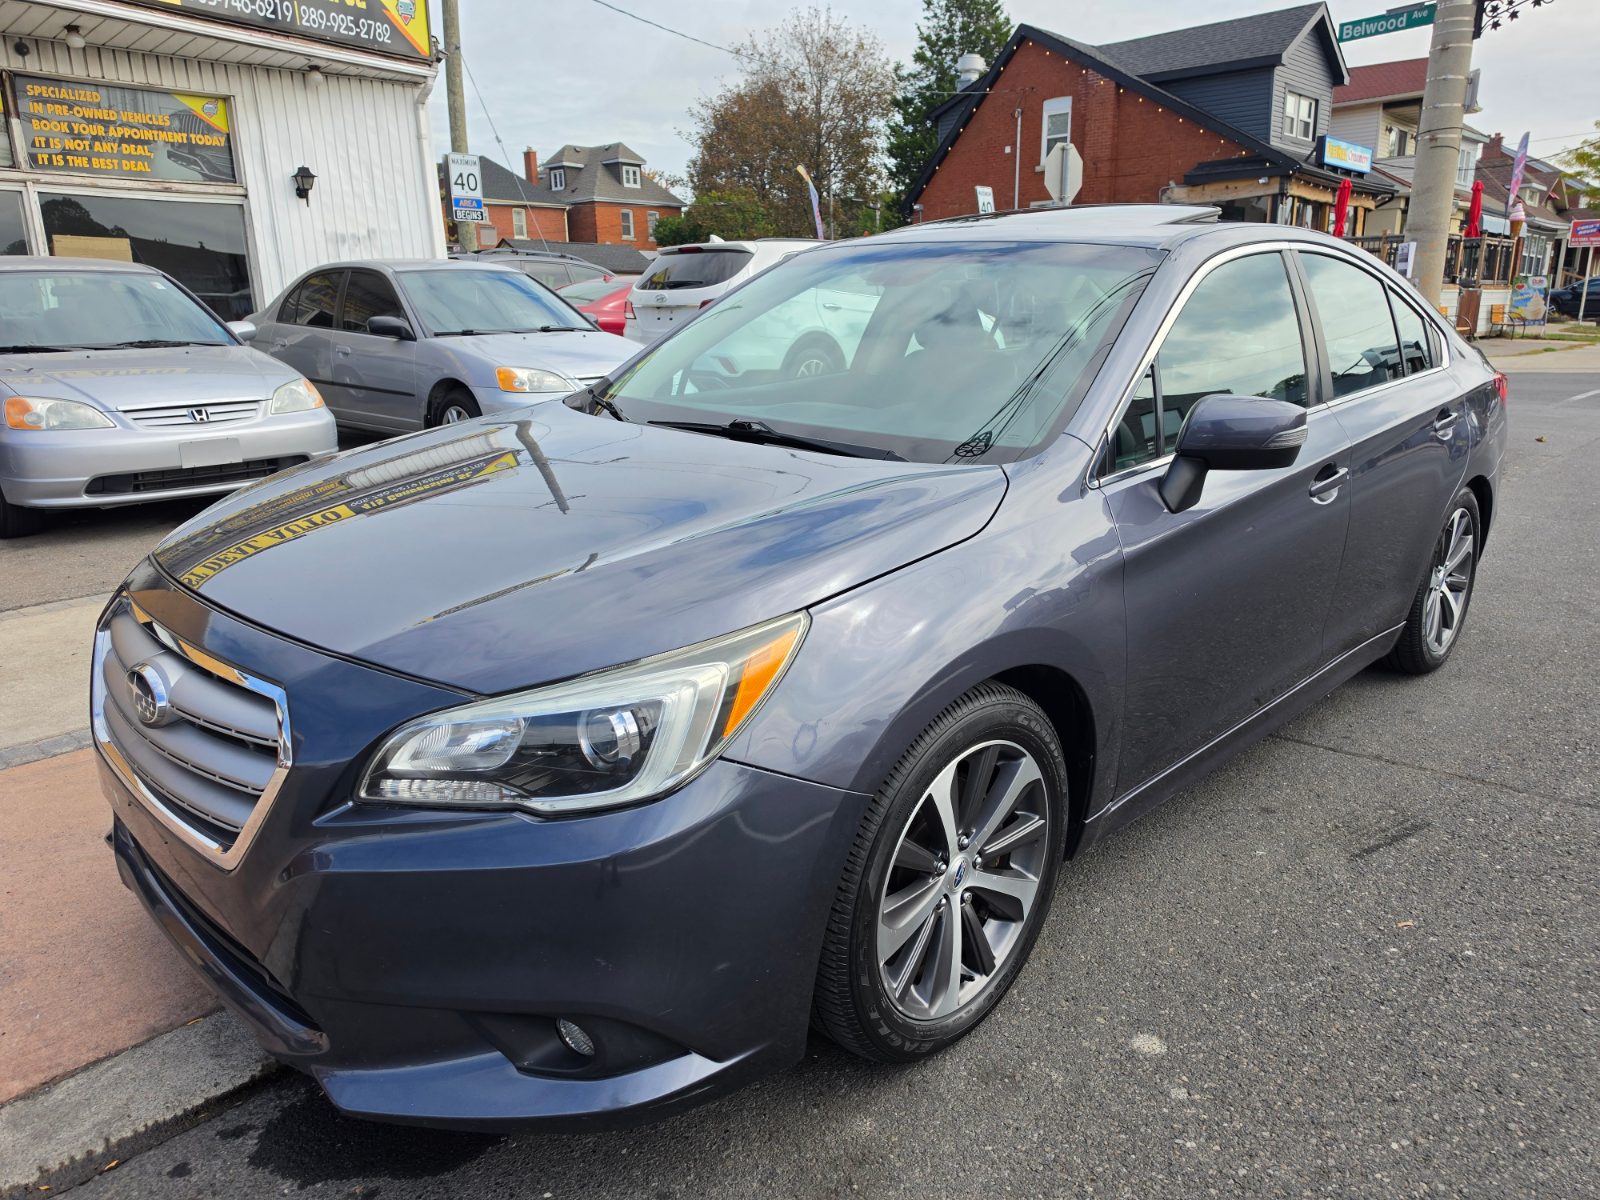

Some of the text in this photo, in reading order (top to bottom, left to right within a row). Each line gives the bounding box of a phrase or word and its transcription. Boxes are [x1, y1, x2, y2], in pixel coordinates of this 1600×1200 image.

[300, 5, 392, 44] 289-925-2782
[1342, 9, 1429, 39] Belwood Ave
[26, 84, 101, 103] SPECIALIZED
[29, 101, 170, 127] IN PRE-OWNED VEHICLES
[31, 118, 226, 147] BOOK YOUR APPOINTMENT TODAY
[34, 136, 154, 159] IT IS NOT ANY DEAL,
[37, 153, 151, 172] IT IS THE BEST DEAL
[451, 158, 477, 166] MAXIMUM
[453, 172, 478, 191] 40
[456, 210, 482, 220] BEGINS
[981, 201, 992, 213] 40
